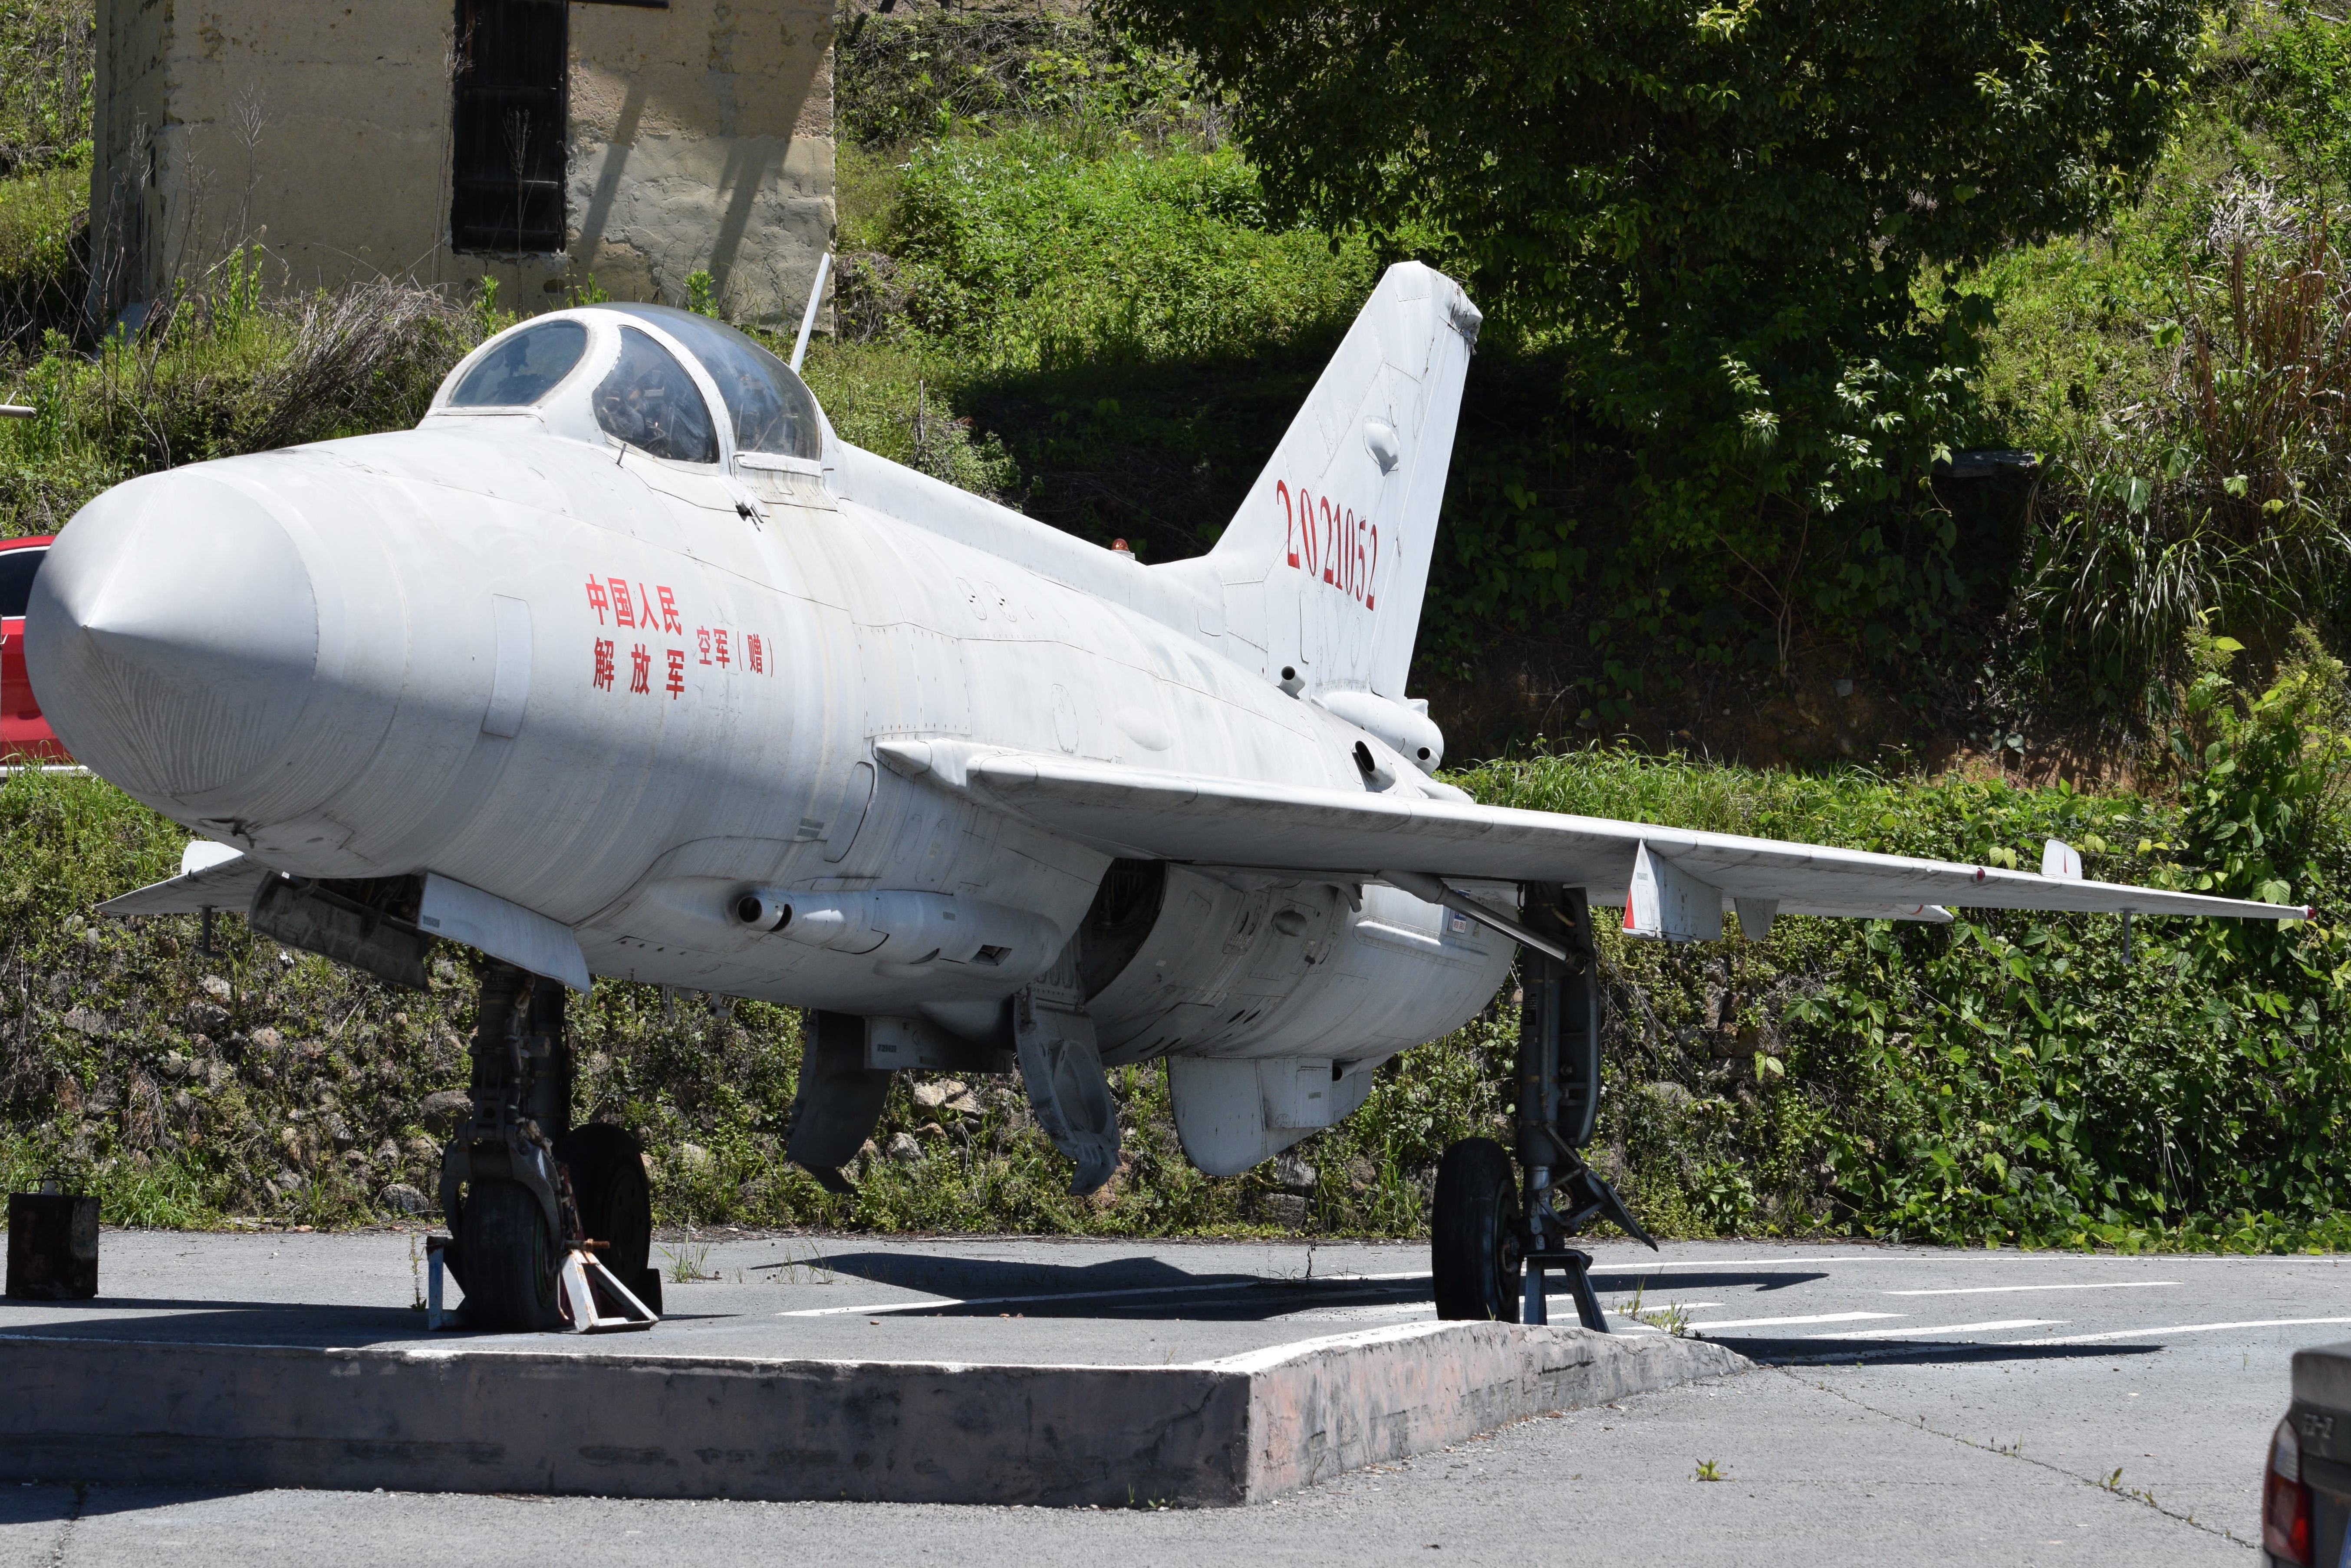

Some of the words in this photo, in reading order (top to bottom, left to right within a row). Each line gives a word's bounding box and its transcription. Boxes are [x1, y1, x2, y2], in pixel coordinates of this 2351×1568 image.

[1277, 479, 1377, 611] 2021052
[585, 573, 682, 636] 中国人民
[593, 637, 685, 700] 解放军
